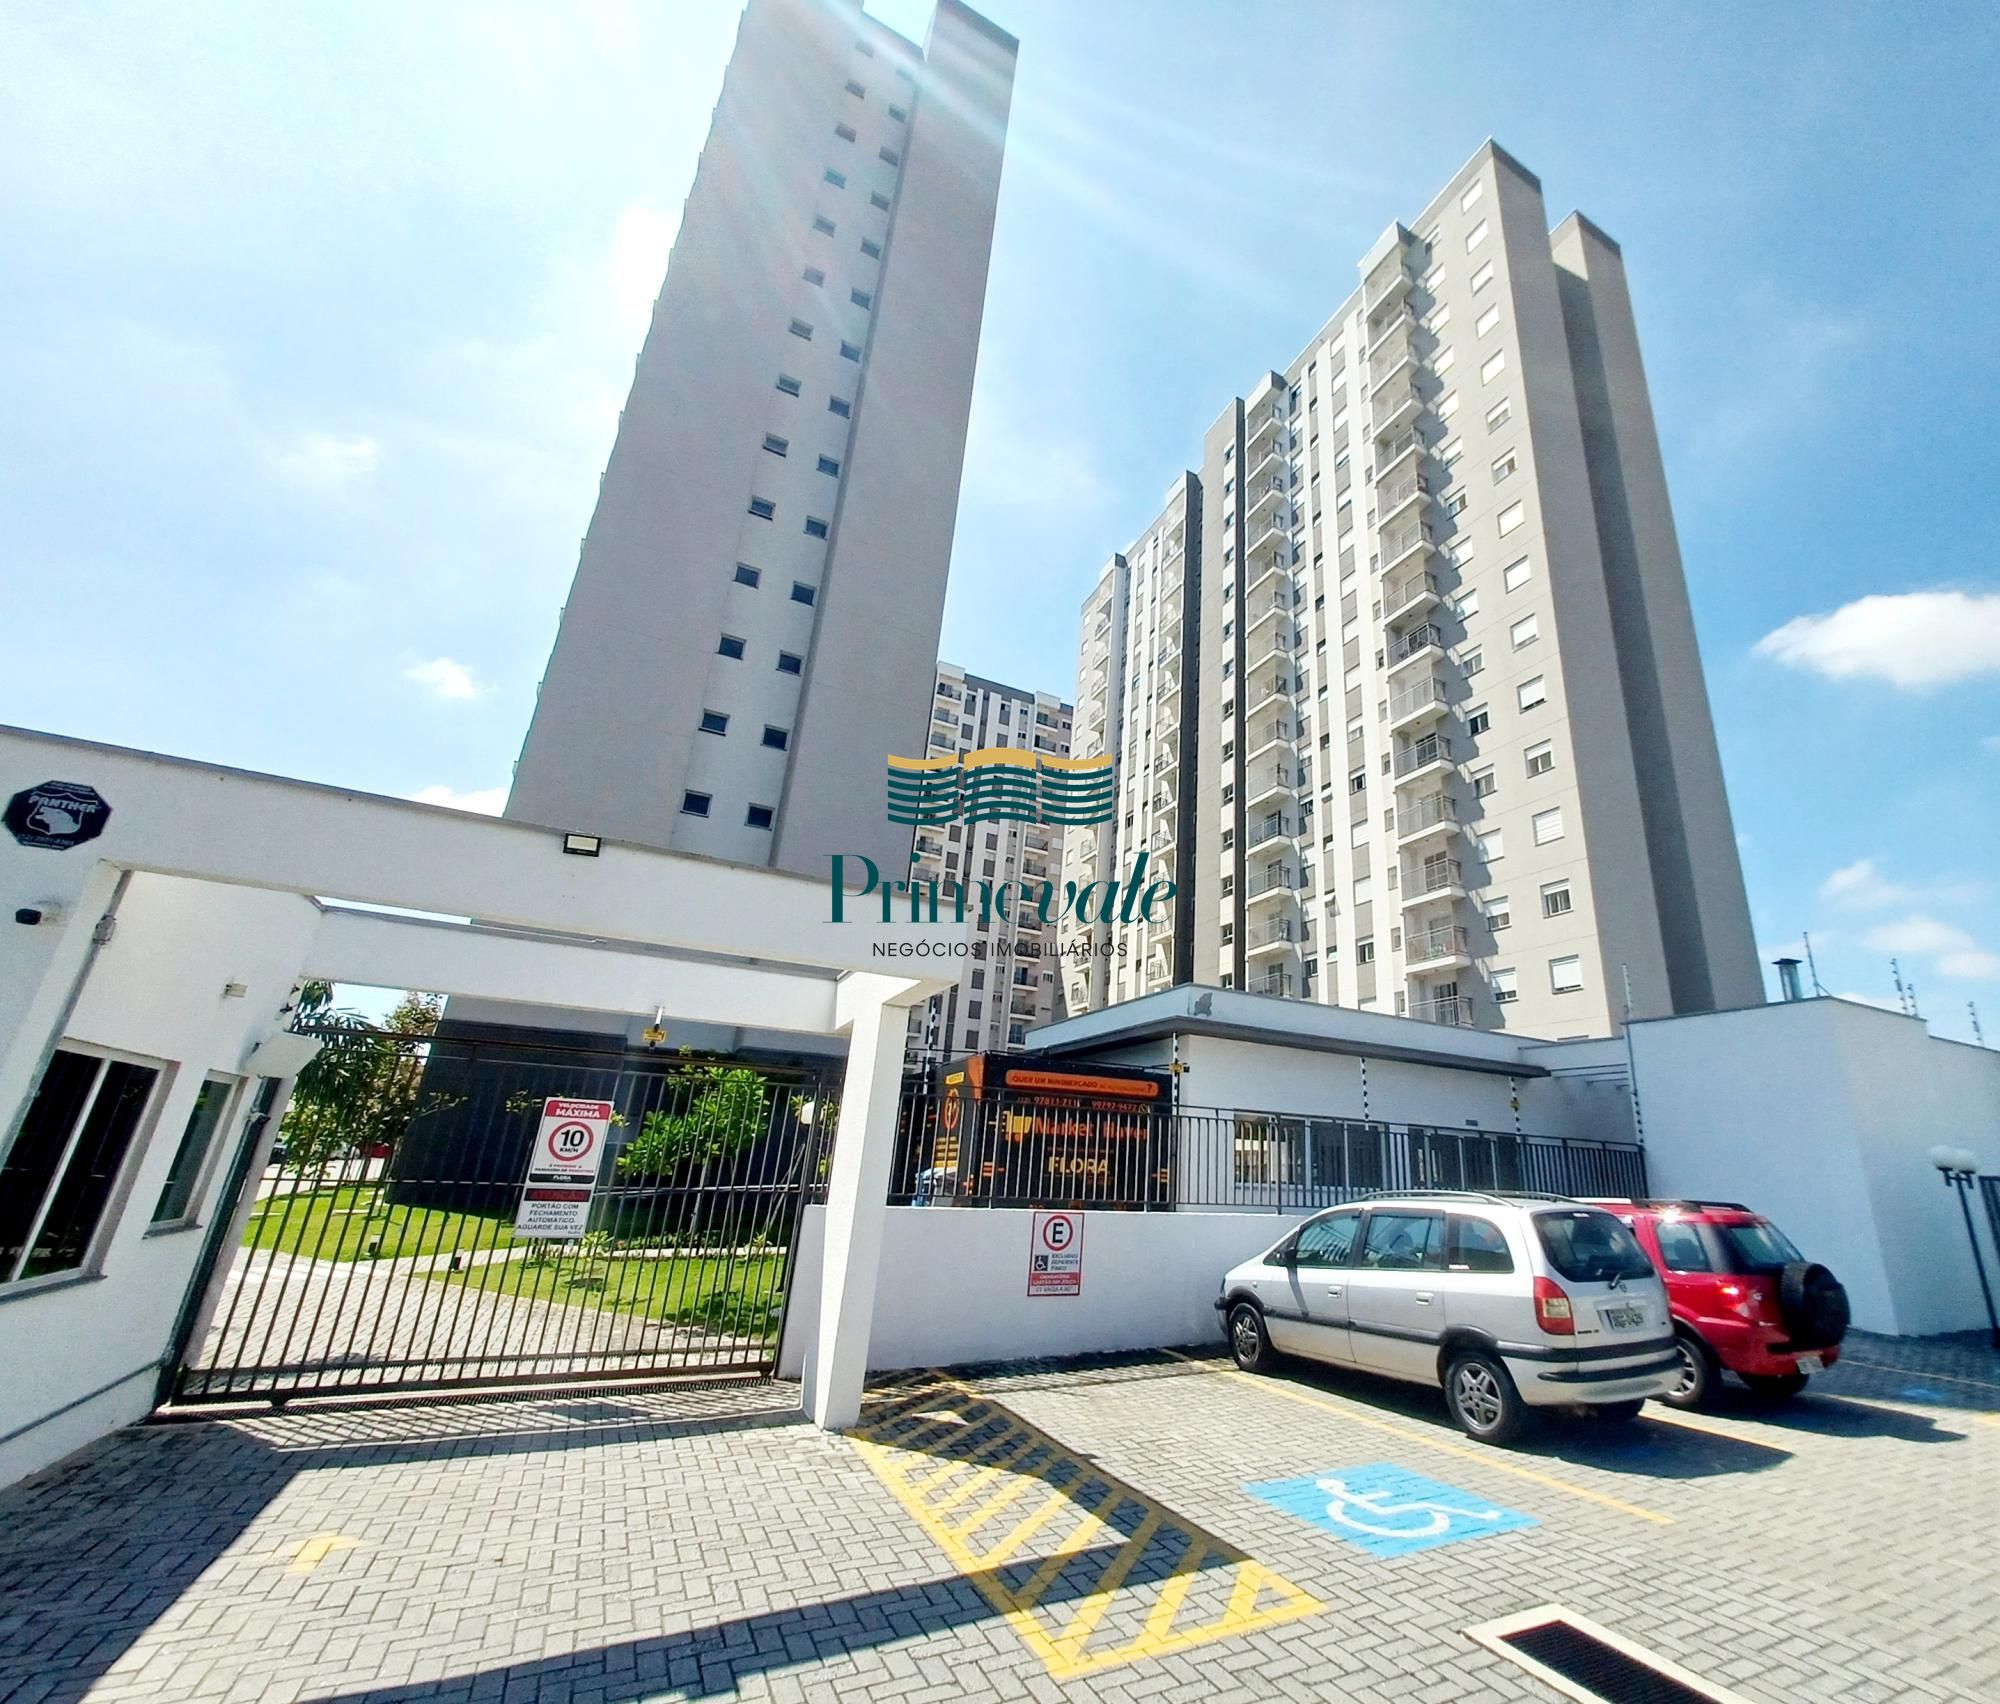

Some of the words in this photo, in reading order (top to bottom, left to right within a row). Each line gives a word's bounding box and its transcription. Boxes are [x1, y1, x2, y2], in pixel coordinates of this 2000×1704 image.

[28, 796, 97, 813] PANTHER
[1034, 1076, 1046, 1085] UM
[555, 1108, 600, 1118] MÁXIMA
[561, 1130, 584, 1147] 10
[1048, 1156, 1110, 1174] FLORA
[1052, 1223, 1064, 1243] E
